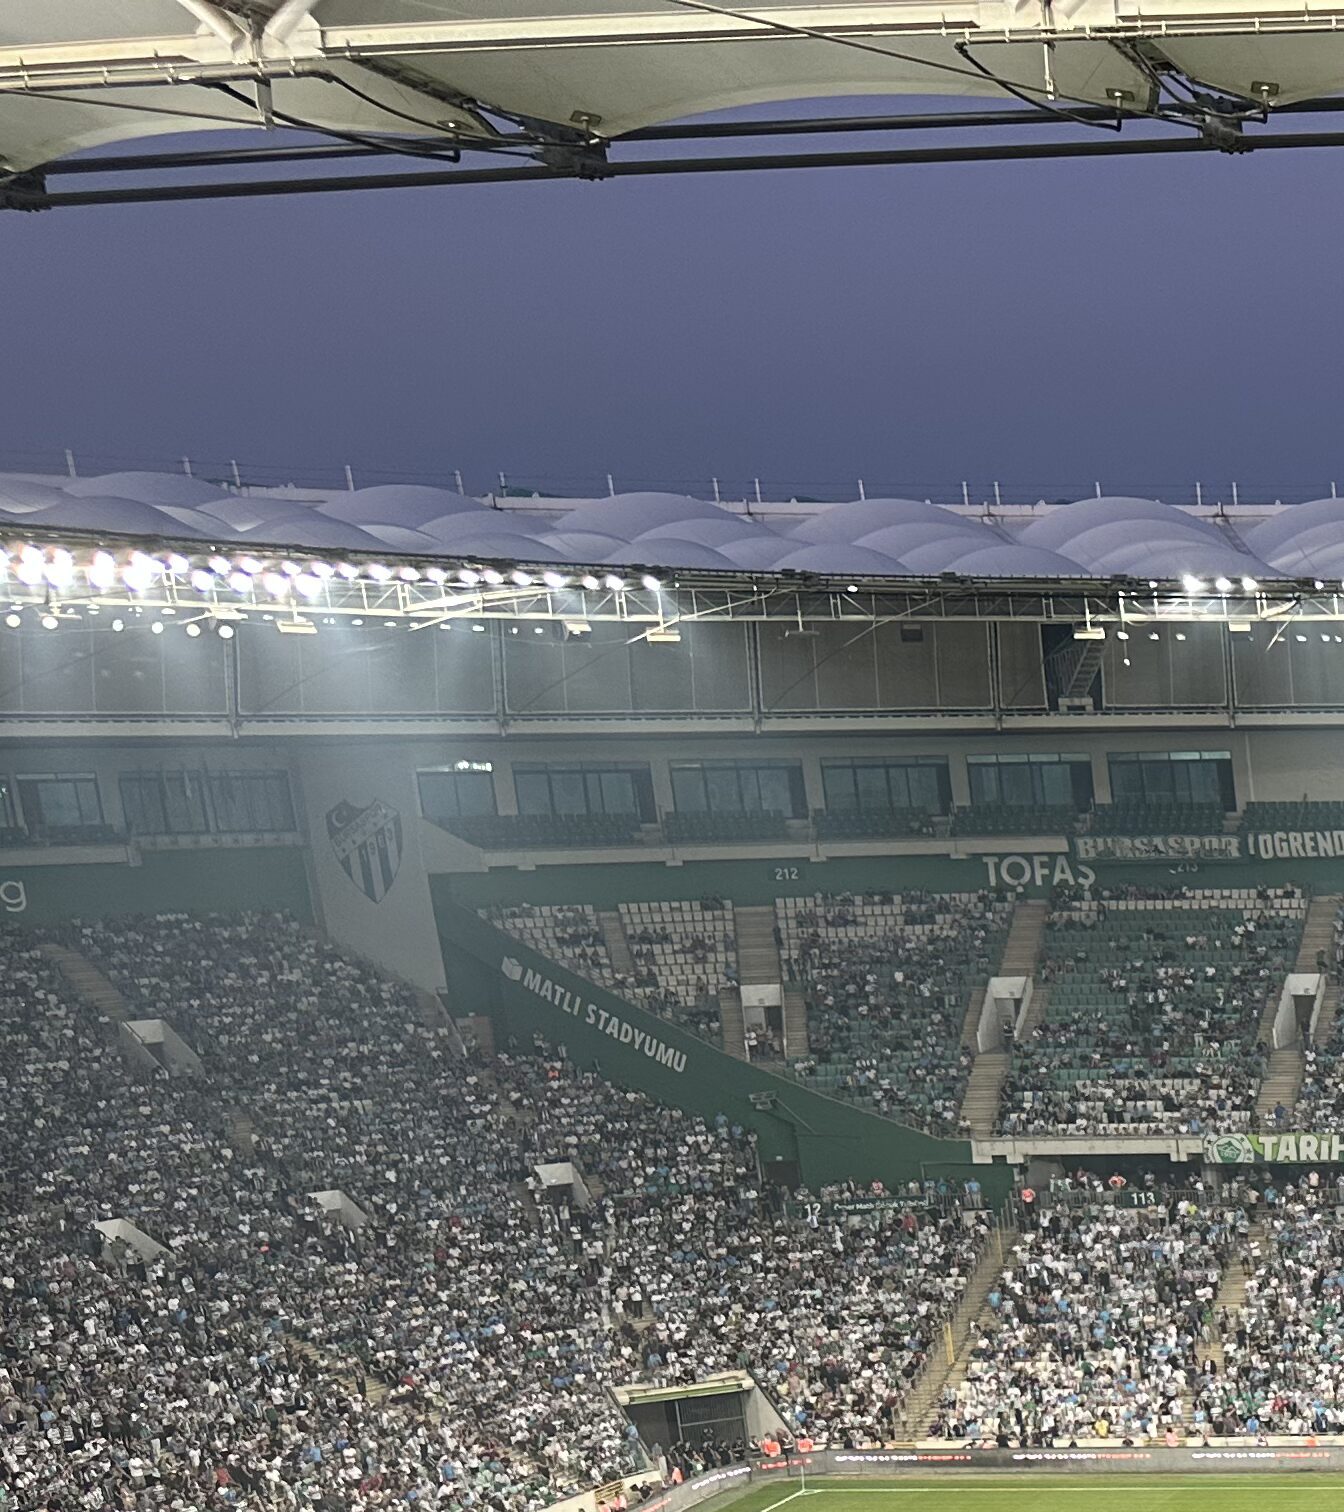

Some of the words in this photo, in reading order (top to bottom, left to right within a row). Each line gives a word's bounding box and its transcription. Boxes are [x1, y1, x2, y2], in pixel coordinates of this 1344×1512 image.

[774, 868, 799, 880] 212
[523, 968, 582, 1016] MATLI
[585, 1003, 688, 1073] STADYUMU
[1131, 1192, 1156, 1206] 113
